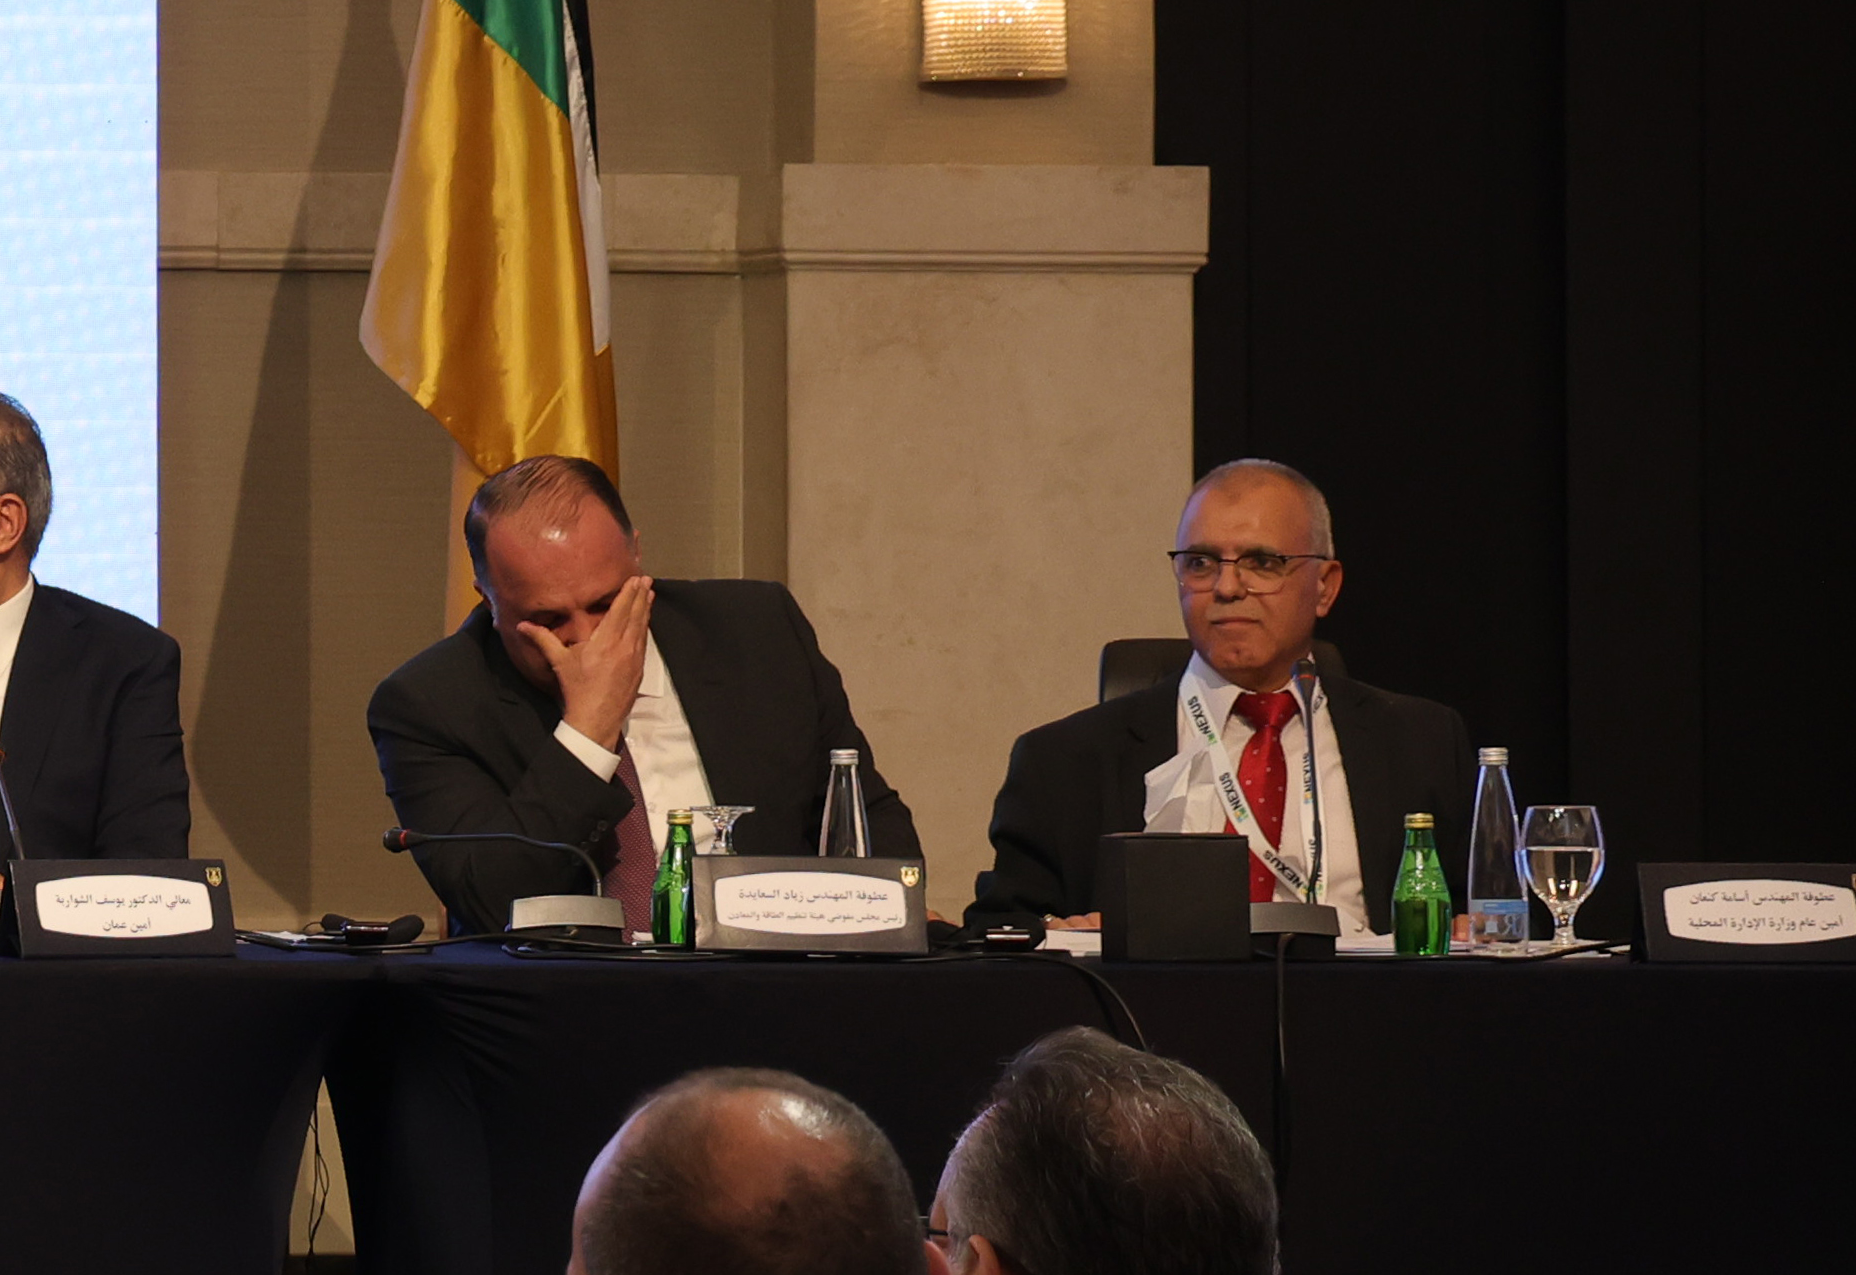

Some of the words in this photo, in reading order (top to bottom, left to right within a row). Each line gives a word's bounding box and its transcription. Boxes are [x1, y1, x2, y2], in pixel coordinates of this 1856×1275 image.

[1187, 695, 1211, 737] NEXUS
[1218, 772, 1243, 812] NEXUS
[1262, 849, 1304, 889] NEXUS
[55, 894, 92, 909] الشواربة
[95, 895, 125, 908] يوسف
[128, 894, 162, 909] الدكتور
[165, 895, 191, 910] معالي
[739, 888, 780, 902] السعايدة
[783, 889, 805, 903] زياد
[806, 889, 853, 903] المهندس
[856, 890, 888, 905] عطوفة
[1689, 891, 1718, 905] كنعان
[1721, 890, 1750, 902] أسامة
[1752, 891, 1800, 906] المهندس
[1803, 891, 1836, 906] عطوفة
[102, 919, 127, 932] عمان
[130, 917, 151, 933] أمين
[1688, 917, 1728, 930] المحلية
[1769, 916, 1796, 932] وزارة
[1799, 919, 1817, 932] عام
